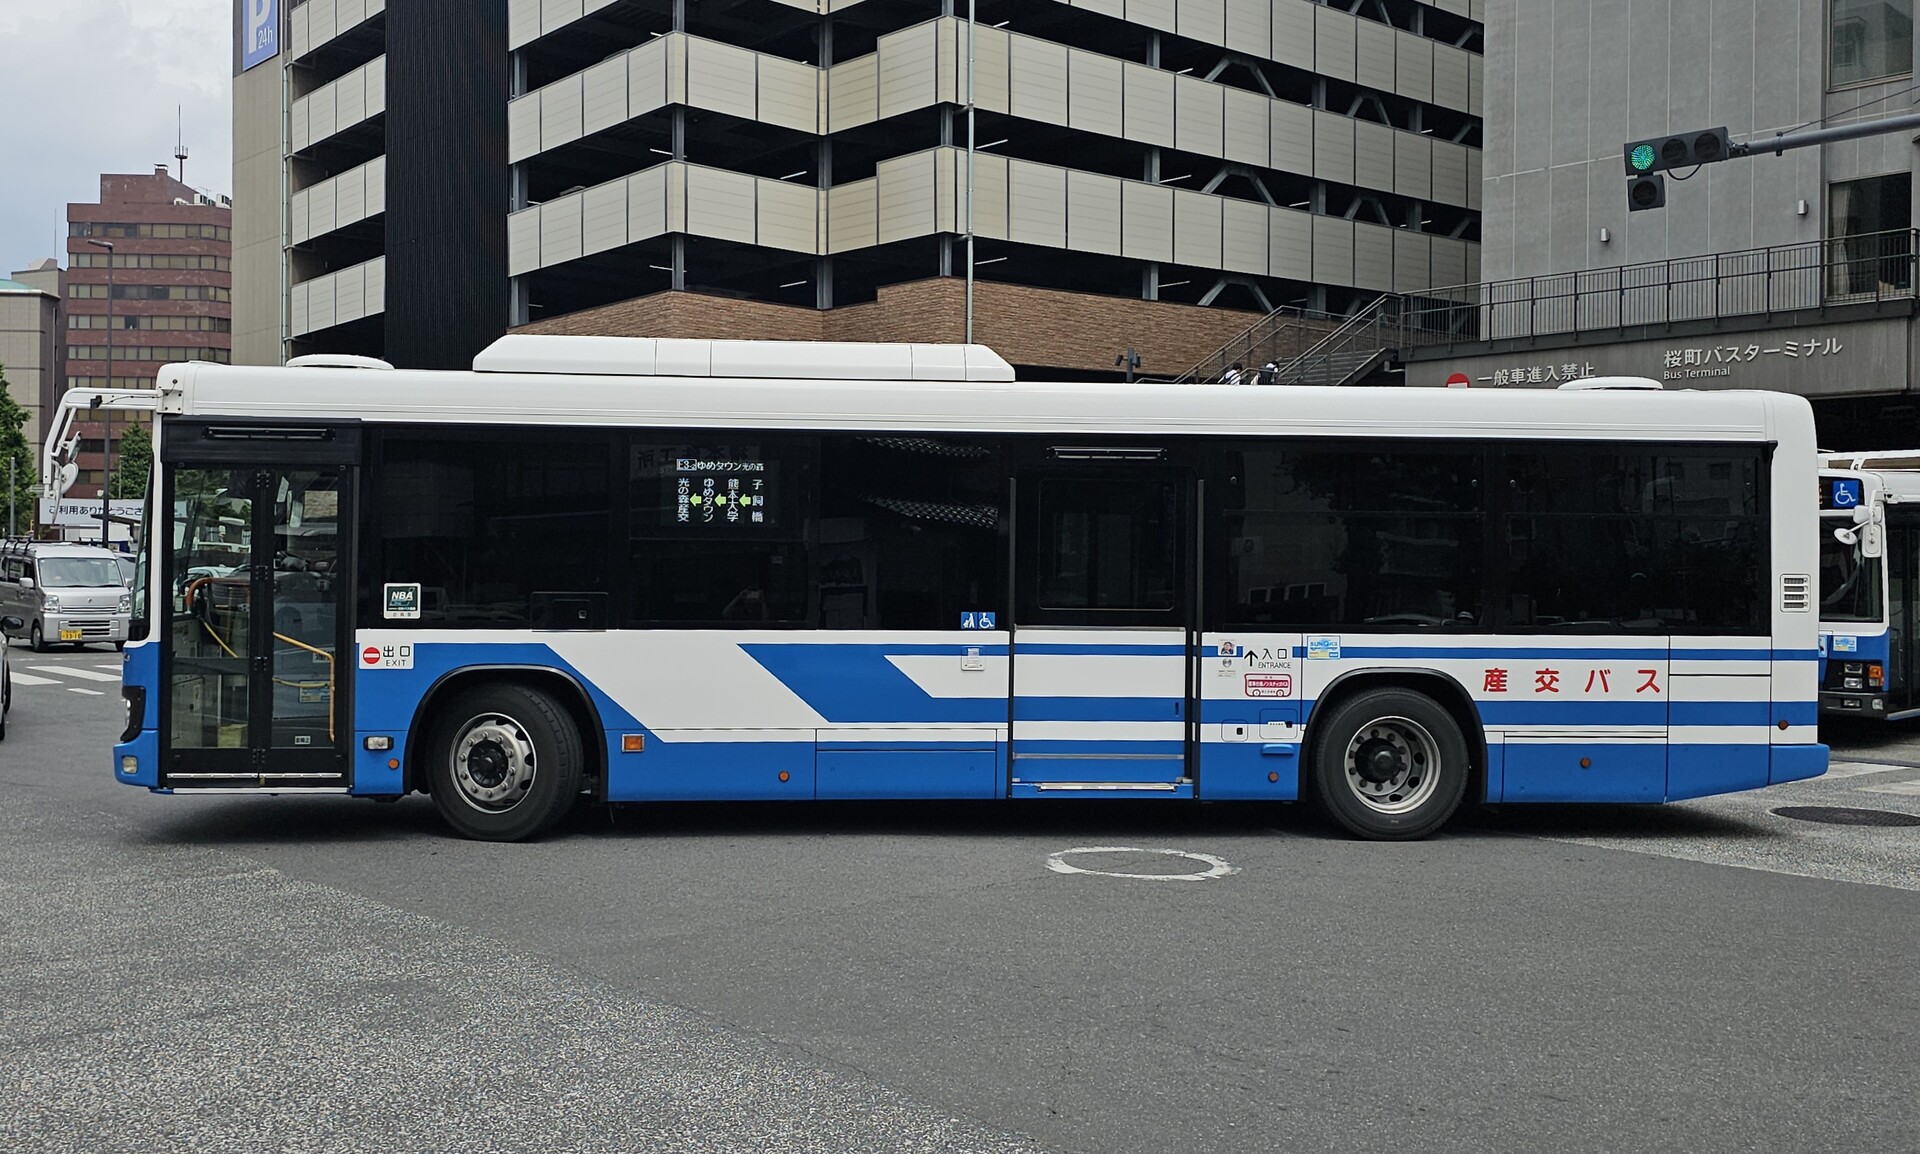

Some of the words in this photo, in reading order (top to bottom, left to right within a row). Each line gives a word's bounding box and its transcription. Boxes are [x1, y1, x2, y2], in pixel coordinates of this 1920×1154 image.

[249, 0, 271, 54] P
[258, 26, 273, 49] 24h
[1664, 338, 1843, 368] 桜町バスターミナル
[1477, 362, 1596, 386] 一般車進入禁止
[1664, 370, 1682, 380] Bus
[1685, 366, 1731, 378] Terminal
[678, 478, 690, 522] 光の森産交
[703, 478, 714, 522] ゆめタウン
[727, 478, 739, 522] 熊本大学
[391, 591, 413, 601] NBA
[382, 645, 411, 658] 出口
[385, 659, 407, 667] EXIT
[1262, 648, 1288, 660] 入口
[1258, 661, 1292, 669] ENTRANCE
[1483, 667, 1661, 693] 産交バス
